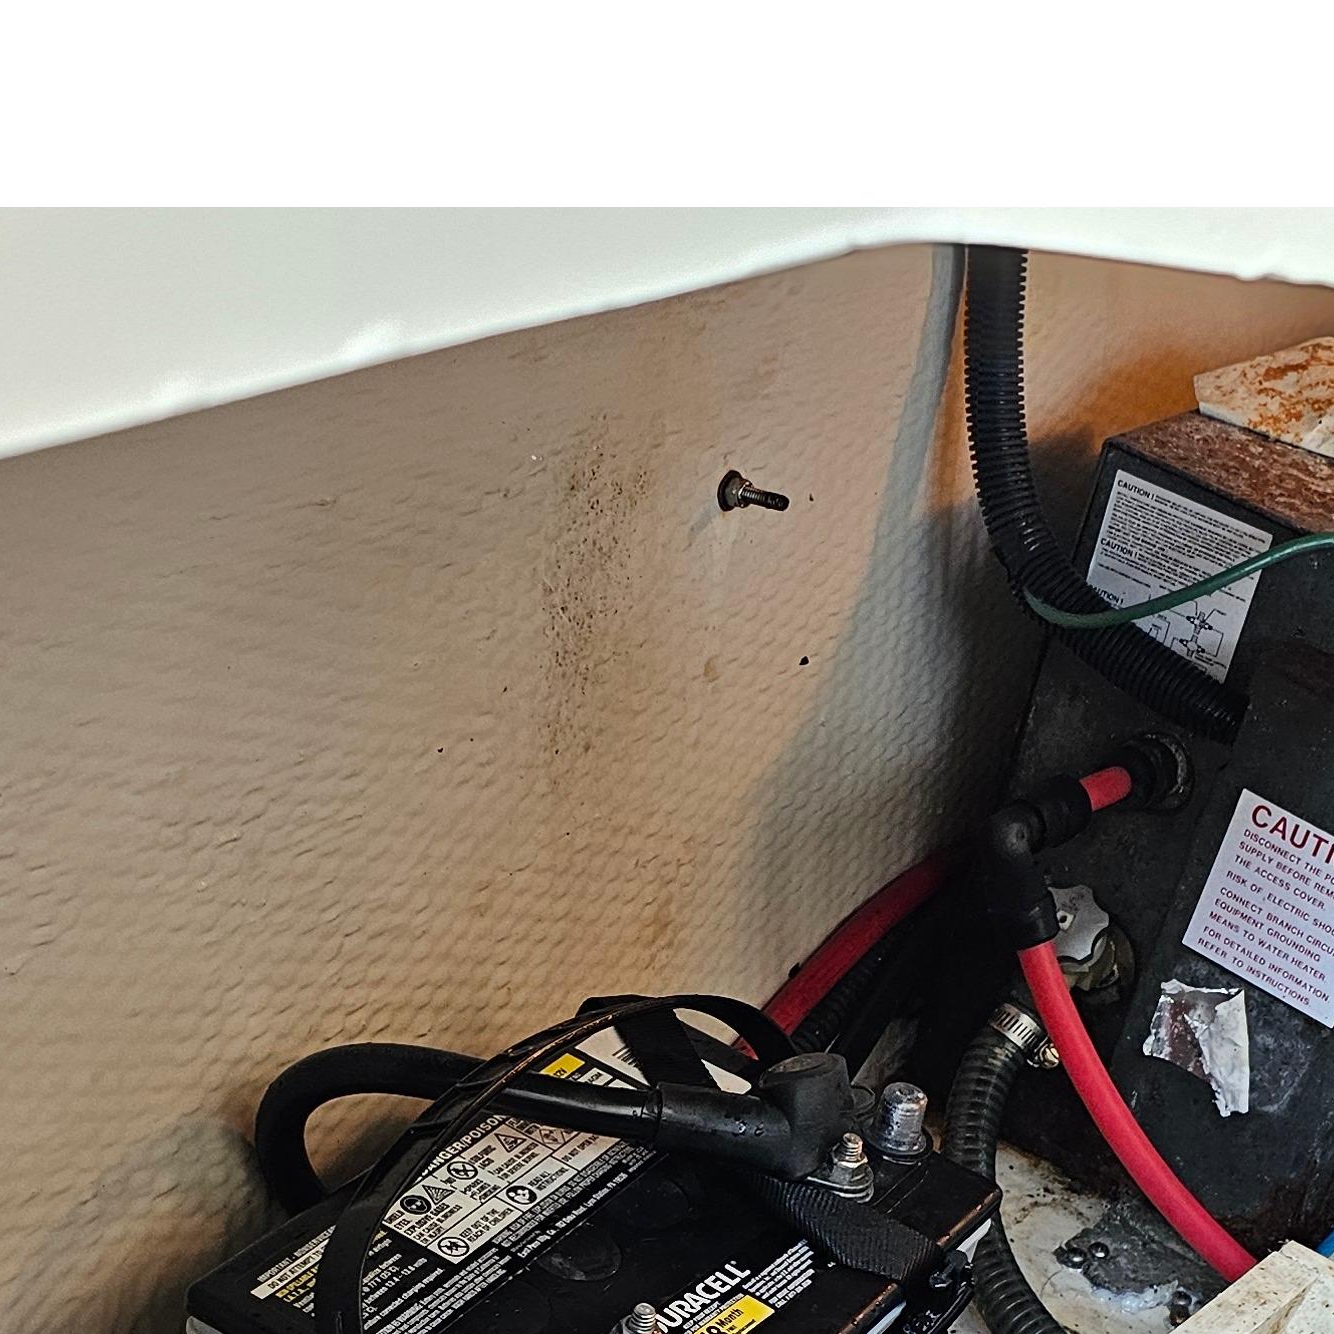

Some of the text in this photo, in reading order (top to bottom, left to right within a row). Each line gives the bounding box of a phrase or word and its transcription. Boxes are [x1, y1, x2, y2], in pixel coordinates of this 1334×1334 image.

[1117, 479, 1152, 499] CAUTION
[1100, 537, 1135, 558] CAUTION
[1238, 841, 1273, 865] SUPPLY
[1275, 861, 1311, 886] BEFORE
[1243, 829, 1301, 865] DISCONNECT
[1303, 861, 1322, 877] THE
[1234, 854, 1251, 869] THE
[1254, 865, 1291, 891] ACCESS
[1226, 870, 1247, 887] RISK
[1249, 883, 1262, 894] OF
[1266, 892, 1310, 921] ELECTRIC
[1219, 886, 1262, 915] CONNECT
[1266, 912, 1303, 938] BRANCH
[1203, 925, 1221, 941] FOR
[1222, 937, 1266, 966] DETAILED
[1209, 910, 1240, 933] MEANS
[1242, 929, 1255, 941] TO
[1257, 938, 1289, 961] WATER
[1214, 898, 1321, 963] EQUIPMENT GROUNDING
[1197, 937, 1227, 958] REFER
[1231, 956, 1243, 968] TO
[502, 1156, 517, 1168] CAUSE
[561, 1138, 592, 1162] DO NOT OPEN
[527, 1169, 550, 1187] READ ALL
[413, 1203, 463, 1240] CAN CAUSE BLINDNESS
[429, 1225, 445, 1237] INJURY
[459, 1207, 499, 1239] KEEP OUT OF THE
[466, 1227, 486, 1243] REACH
[481, 1223, 492, 1231] OF
[256, 1256, 292, 1282] IMPORTANT
[266, 1280, 279, 1288] DO
[275, 1272, 291, 1283] NOT
[714, 1305, 744, 1329] Month
